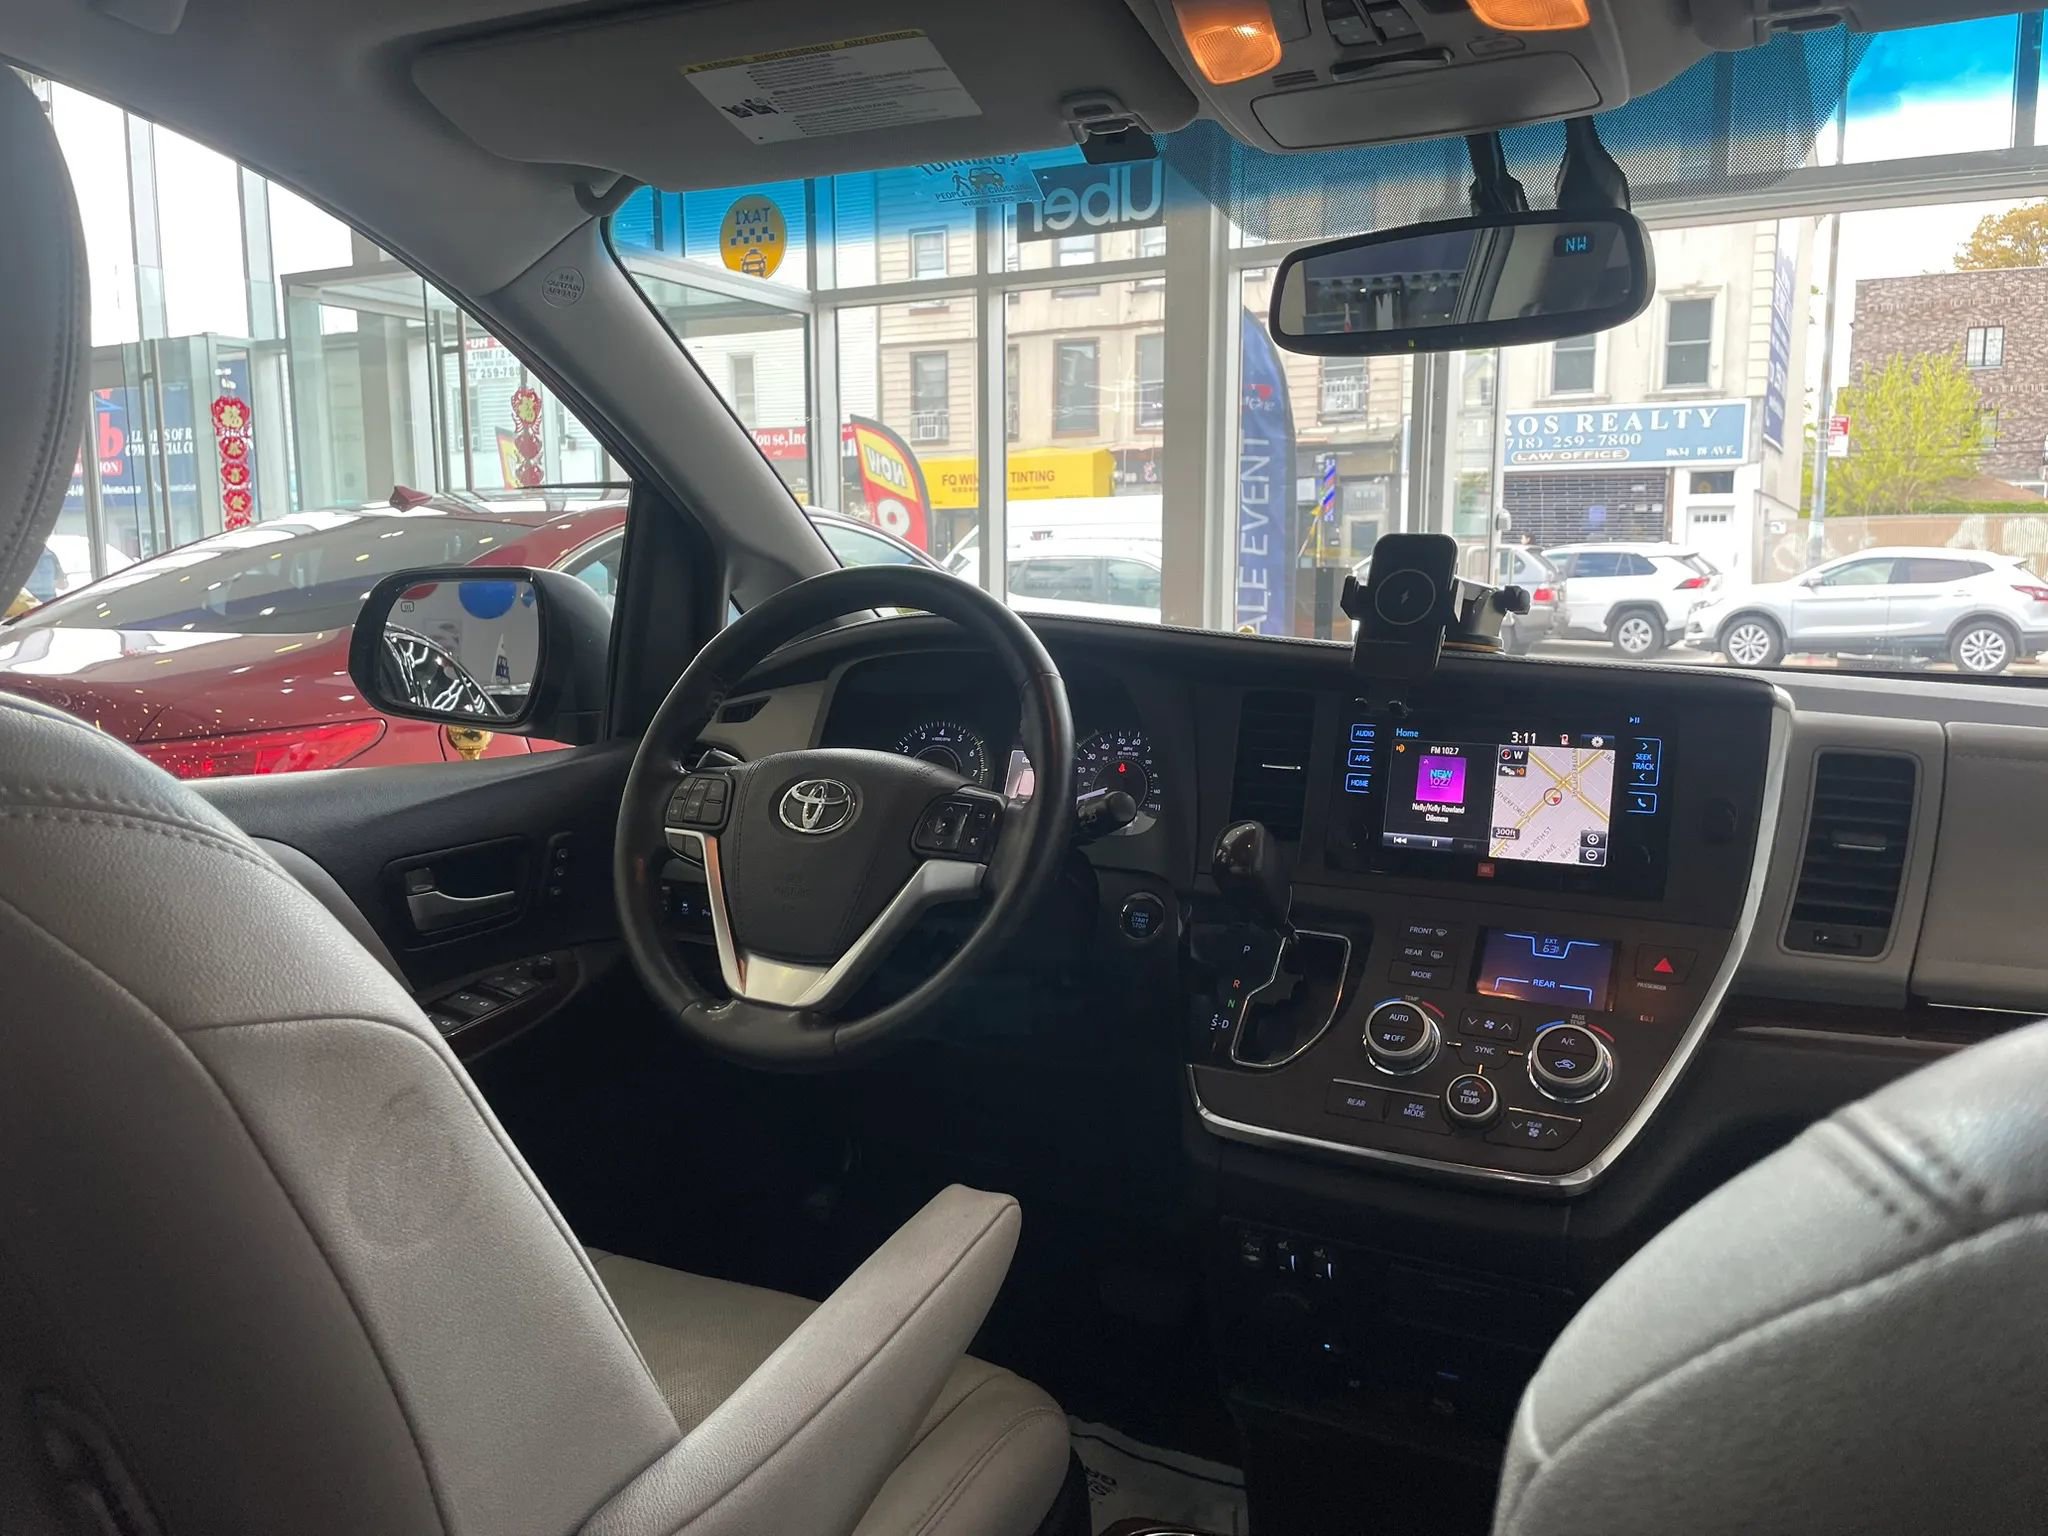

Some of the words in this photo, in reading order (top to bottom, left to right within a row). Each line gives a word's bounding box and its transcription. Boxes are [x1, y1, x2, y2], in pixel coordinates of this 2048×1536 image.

[1565, 235, 1587, 253] NW
[1576, 407, 1720, 433] REALTY
[1516, 451, 1557, 462] LAW
[1560, 449, 1624, 461] OFFICE
[1009, 470, 1056, 484] TINTING
[1240, 431, 1271, 556] EVENT
[1355, 730, 1375, 738] AUDIO
[1395, 727, 1419, 738] Home
[1510, 731, 1537, 745] 3:11
[1430, 746, 1441, 754] FM
[1442, 746, 1460, 755] 102.7
[1513, 751, 1525, 760] W
[1086, 753, 1097, 761] 30
[1354, 754, 1371, 763] APPS
[1635, 753, 1652, 763] SEEK
[1077, 766, 1087, 774] 20
[1632, 762, 1655, 771] TRACK
[1429, 769, 1453, 779] NEW
[1350, 779, 1369, 788] HOME
[1441, 805, 1465, 814] Rowland
[1425, 813, 1449, 823] Dilemma
[1131, 916, 1149, 925] START
[1409, 926, 1433, 935] FRONT
[1243, 945, 1250, 953] P
[1404, 947, 1423, 957] REAR
[1410, 969, 1432, 980] MODE
[1233, 979, 1240, 988] R
[1532, 979, 1556, 989] REAR
[1227, 999, 1235, 1008] N
[1388, 1012, 1409, 1023] AUTO
[1391, 1034, 1406, 1044] OFF
[1560, 1036, 1576, 1047] A/C
[1474, 1045, 1495, 1056] SYNC
[1462, 1090, 1479, 1098] REAR
[1347, 1097, 1367, 1108] REAR
[1459, 1096, 1481, 1106] TEMP
[1408, 1103, 1424, 1111] REAR
[1403, 1109, 1425, 1119] MODE
